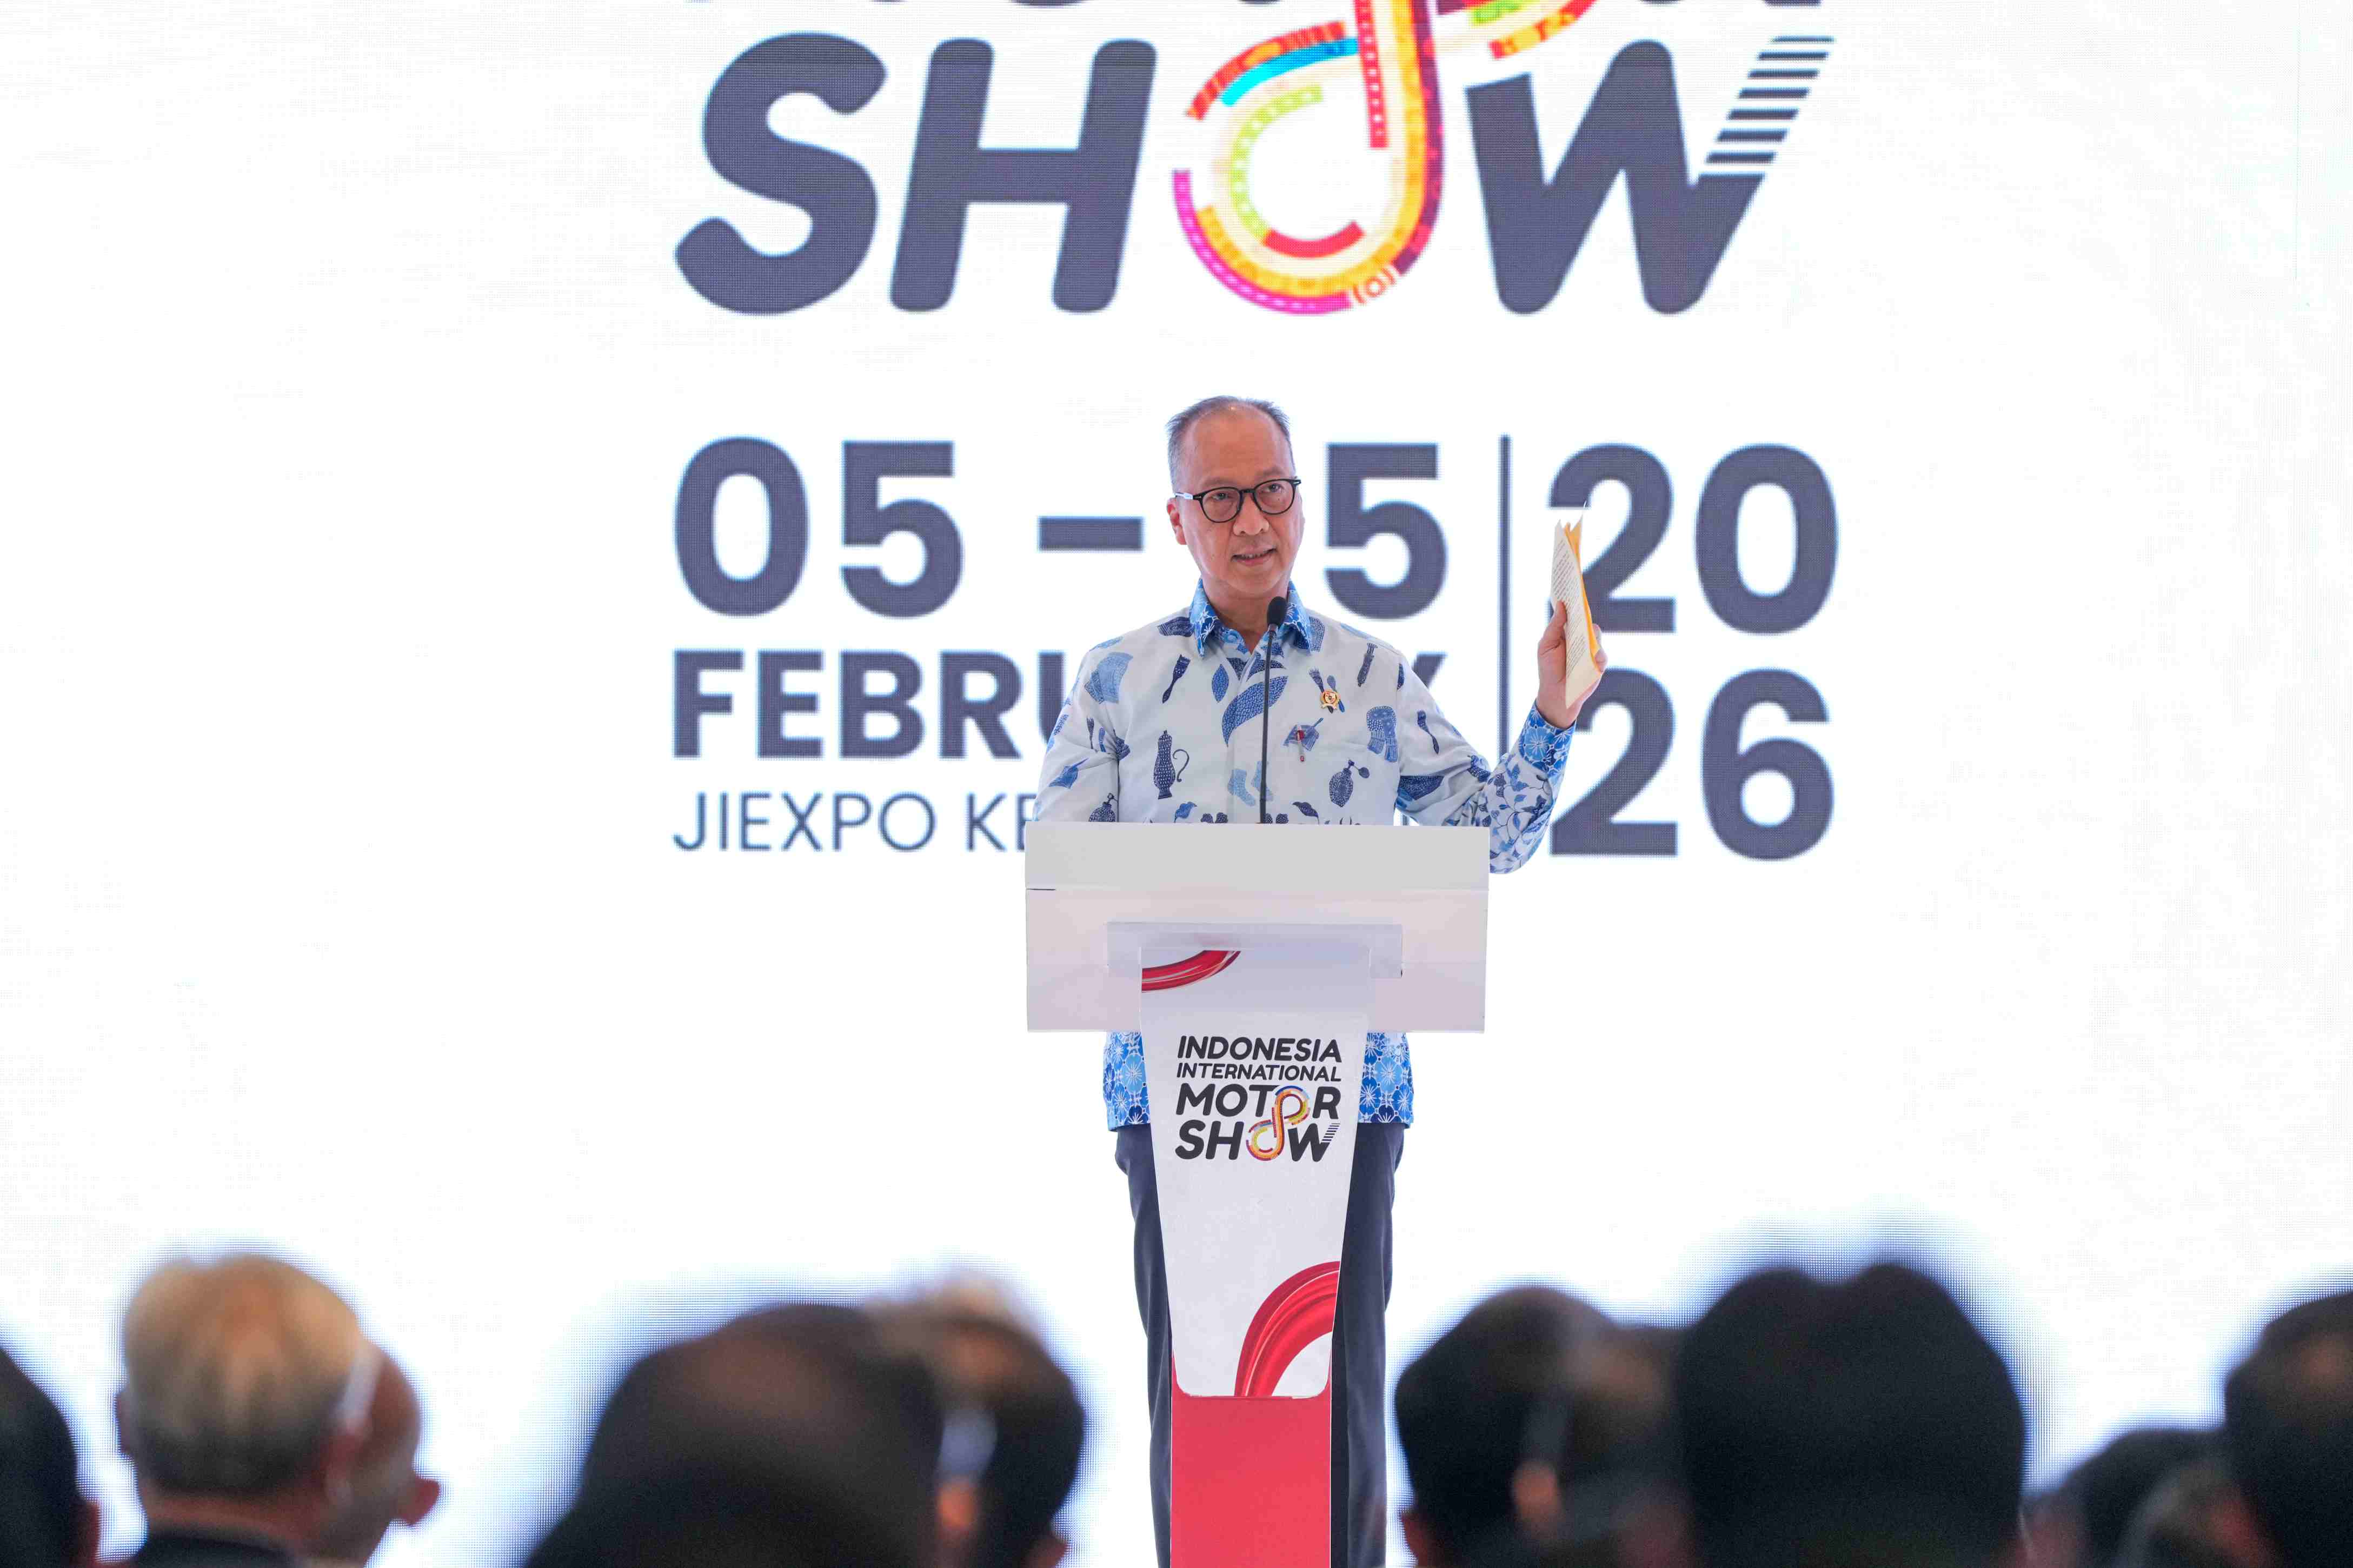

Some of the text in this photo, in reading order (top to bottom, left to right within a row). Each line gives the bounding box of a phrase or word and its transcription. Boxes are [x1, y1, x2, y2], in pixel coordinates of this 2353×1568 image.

[674, 436, 963, 618] 05
[1323, 442, 1449, 619] 5
[1548, 443, 1838, 635] 20
[1550, 668, 1834, 861] 26
[673, 792, 936, 852] JIEXPO
[1176, 1063, 1341, 1082] INTERNATIONAL
[1177, 1035, 1342, 1063] INDONESIA
[1175, 1083, 1341, 1120] MOTOR
[1175, 1119, 1341, 1162] SHOW
